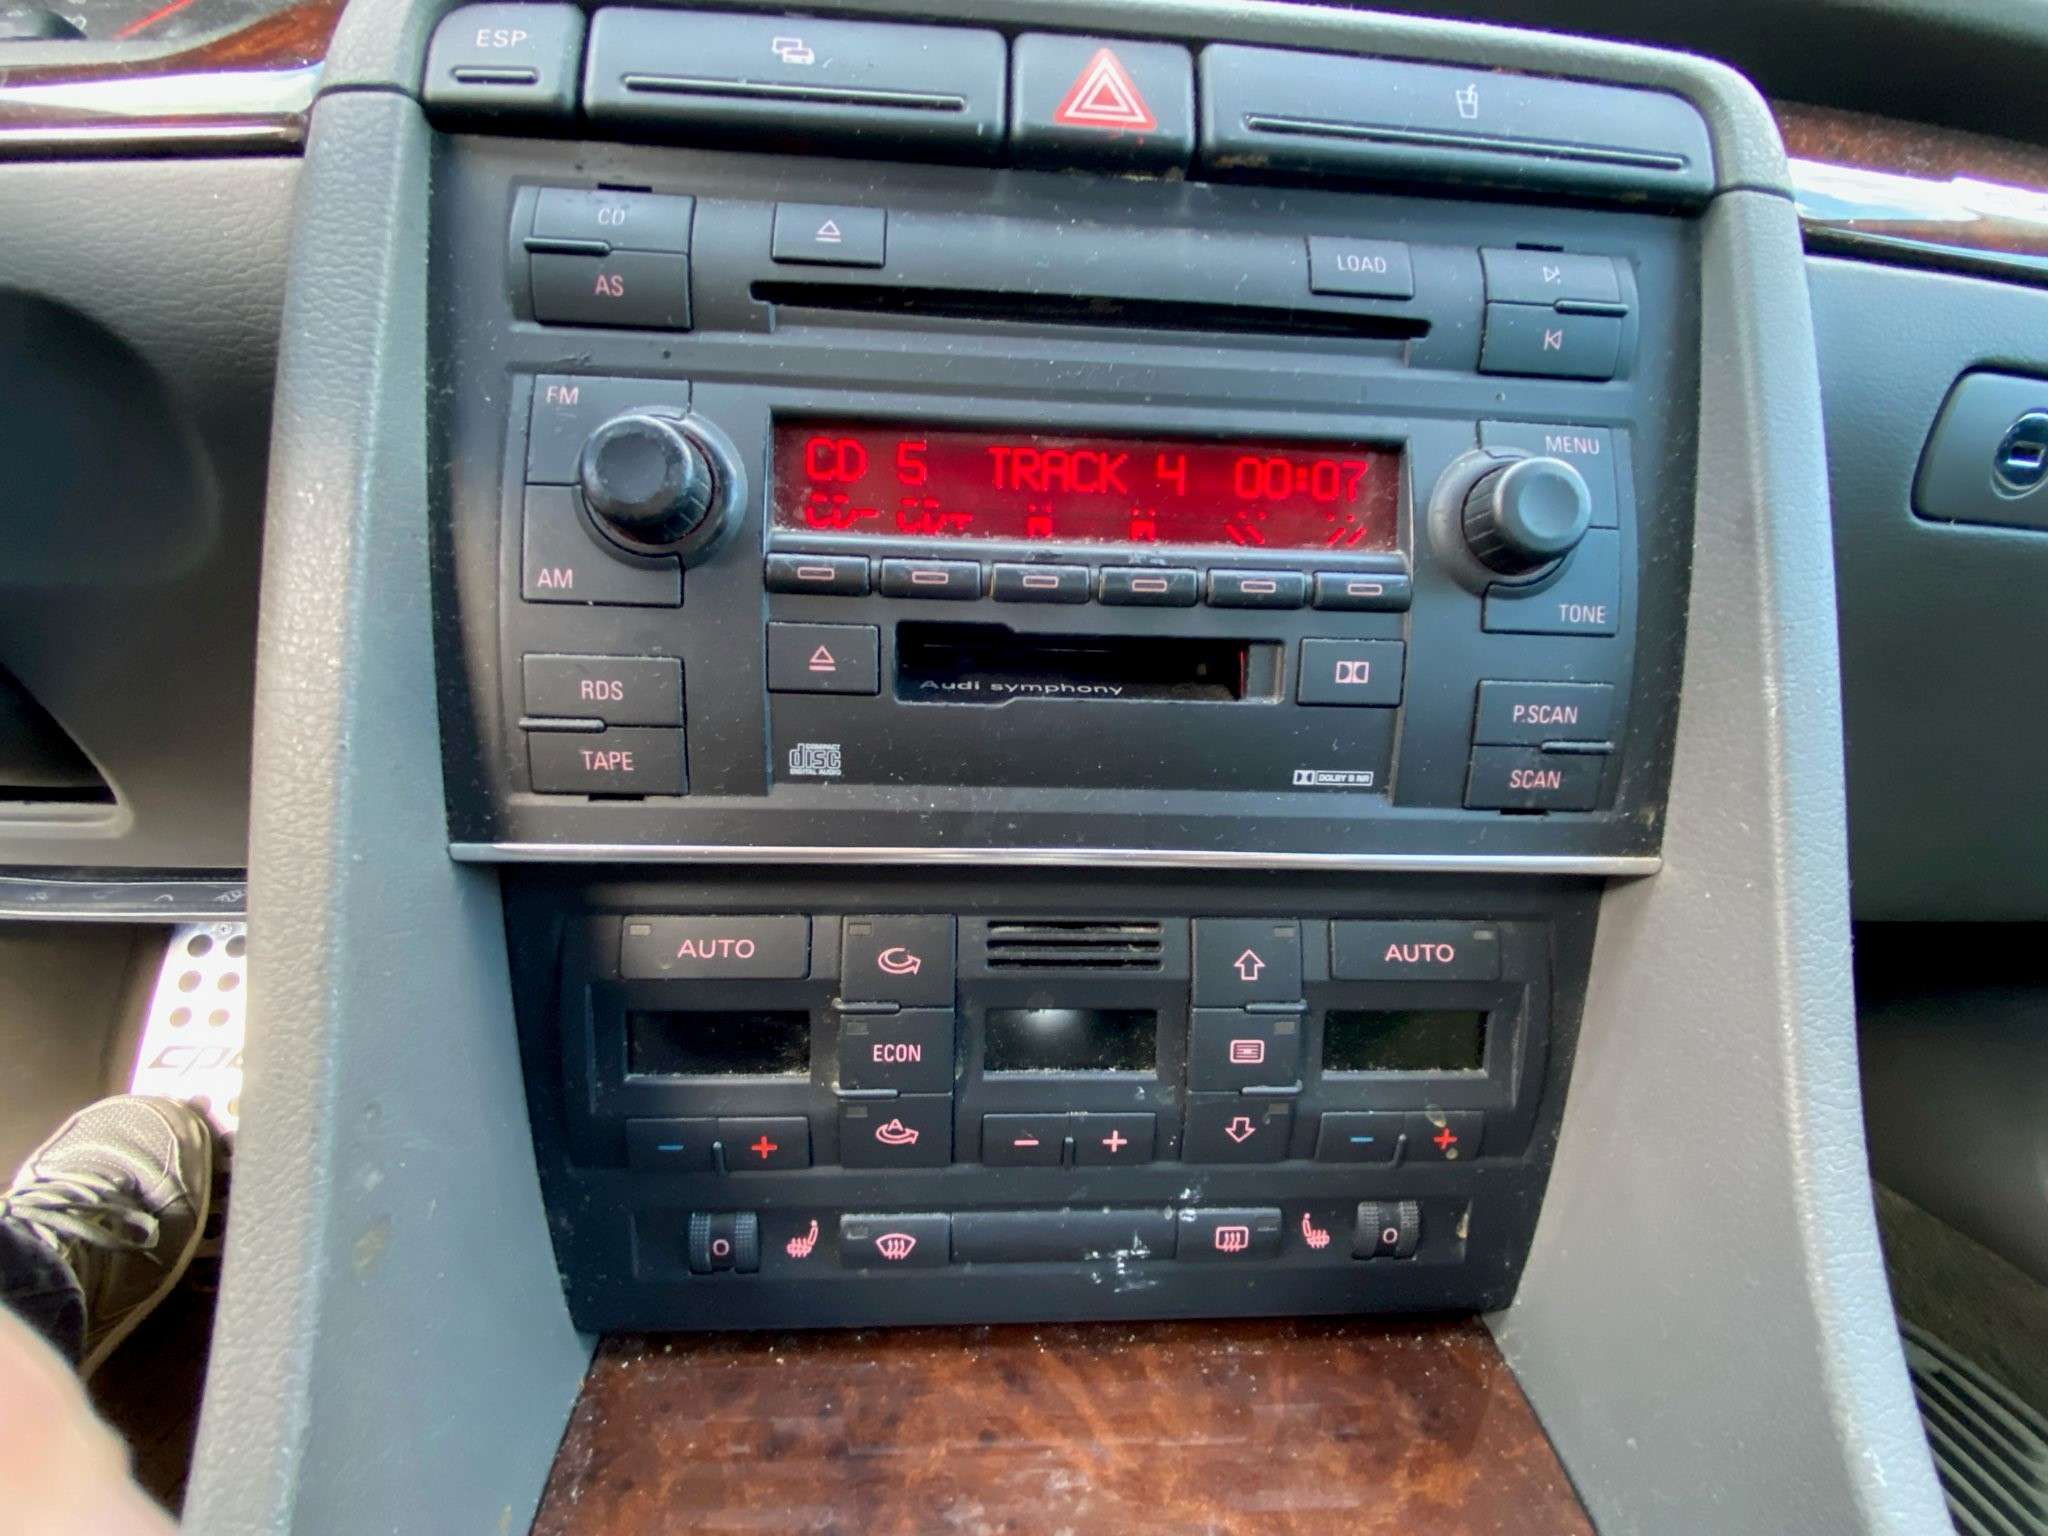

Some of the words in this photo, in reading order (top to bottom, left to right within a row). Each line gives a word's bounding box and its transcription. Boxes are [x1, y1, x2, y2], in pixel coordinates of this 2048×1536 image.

[475, 29, 528, 48] ESP
[598, 207, 627, 227] CD
[1336, 254, 1387, 274] LOAD
[594, 274, 625, 297] AS
[545, 385, 580, 406] FM
[1545, 435, 1600, 456] MENU
[804, 437, 867, 483] CD
[987, 446, 1130, 493] TRACK
[1155, 453, 1187, 496] 4
[1233, 455, 1368, 503] 00:07
[537, 567, 574, 590] AM
[1558, 603, 1607, 625] TONE
[581, 680, 624, 701] RDS
[920, 679, 980, 691] Audi
[989, 681, 1123, 696] symphony
[1513, 704, 1579, 726] P.SCAN
[582, 750, 635, 773] TAPE
[1509, 768, 1562, 791] SCAN
[677, 938, 756, 960] AUTO
[1384, 943, 1456, 964] AUTO
[872, 1043, 922, 1063] ECON
